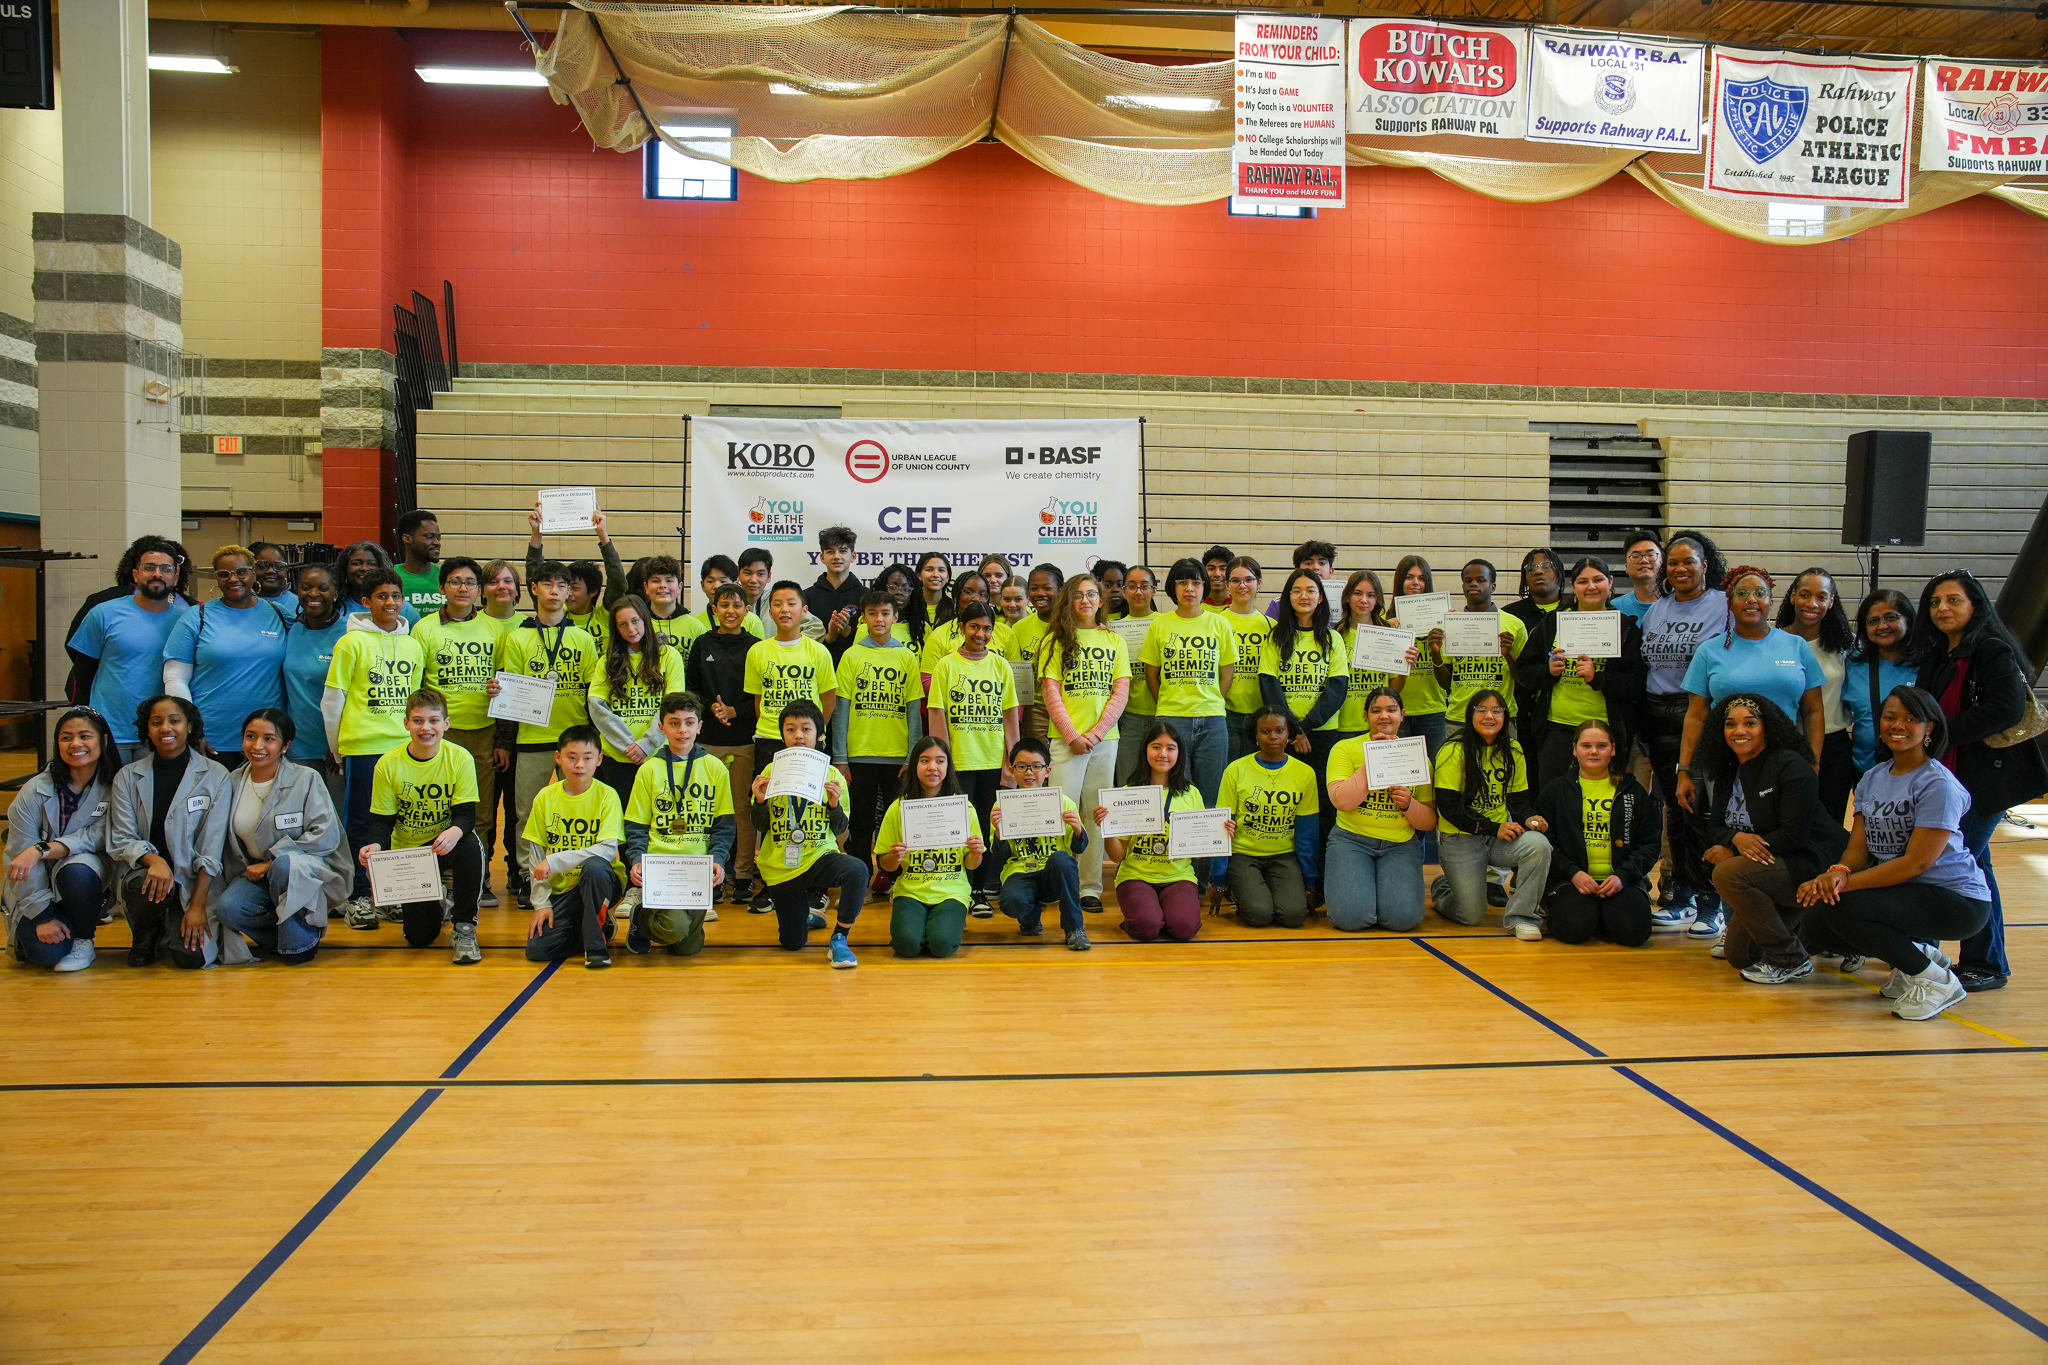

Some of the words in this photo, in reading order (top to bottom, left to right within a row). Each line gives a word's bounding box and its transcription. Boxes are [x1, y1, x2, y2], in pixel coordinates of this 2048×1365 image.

[1257, 24, 1318, 41] REMINDERS
[1239, 42, 1268, 58] FROM
[1272, 44, 1301, 60] YOUR
[1305, 46, 1340, 60] CHILD:
[1386, 29, 1491, 61] BUTCH
[1545, 39, 1632, 59] RAHWAY
[1634, 47, 1688, 64] P.B.A.
[1590, 58, 1628, 69] LOCAL
[1629, 61, 1645, 72] #31
[1264, 70, 1277, 80] KID
[1373, 57, 1505, 89] KOWAL'S
[1245, 85, 1256, 94] It's
[1258, 86, 1271, 95] Just
[1278, 87, 1299, 97] GAME
[1741, 86, 1791, 100] POLICE
[1817, 82, 1896, 110] Rahway
[1245, 101, 1256, 112] My
[1257, 101, 1277, 111] Coach
[1279, 103, 1285, 111] is
[1292, 103, 1334, 113] VOLUNTEER
[1356, 94, 1516, 119] ASSOCIATION
[1948, 102, 1981, 121] Local
[1994, 111, 2004, 121] 33
[1245, 117, 1258, 127] The
[1259, 118, 1288, 128] Referees
[1303, 120, 1335, 129] HUMANS
[1375, 117, 1428, 133] Supports
[1431, 118, 1477, 133] RAHWAY
[1479, 121, 1499, 135] PAL
[1728, 98, 1758, 154] ATHLETIC
[1742, 101, 1783, 137] PAL
[1815, 115, 1889, 137] POLICE
[1535, 116, 1597, 135] Supports
[1599, 121, 1654, 142] Rahway
[1655, 127, 1691, 143] P.A.L.
[1766, 113, 1799, 154] LEAGUE
[1245, 134, 1257, 143] NO
[1258, 135, 1284, 146] College
[1286, 136, 1329, 147] Scholarships
[1330, 137, 1342, 145] will
[1947, 128, 2048, 156] FMB
[1249, 147, 1258, 156] be
[1260, 148, 1287, 157] Handed
[1289, 148, 1302, 157] Out
[1303, 149, 1323, 159] Today
[1800, 140, 1902, 162] ATHLETIC
[1948, 155, 1995, 171] Supports
[1998, 160, 2042, 172] RAHWAY
[1247, 165, 1302, 185] RAHWAY
[1305, 167, 1337, 187] P.A.L.
[1724, 168, 1775, 179] Established
[1779, 174, 1796, 183] 1995
[1811, 165, 1890, 186] LEAGUE
[1244, 186, 1269, 195] THANK
[218, 437, 239, 453] EXIT
[726, 442, 815, 470] KOBO
[891, 454, 922, 462] URBAN
[923, 454, 957, 462] LEAGUE
[1039, 446, 1102, 465] BASF
[727, 469, 815, 479] www.koboproducts.com
[905, 463, 934, 471] UNION
[1006, 471, 1021, 480] We
[1023, 471, 1053, 480] create
[1055, 470, 1101, 482] chemistry
[766, 500, 804, 514] YOU
[1058, 501, 1098, 515] YOU
[767, 514, 782, 524] BE
[784, 514, 804, 524] THE
[877, 506, 952, 534] CEF
[1058, 515, 1072, 526] BE
[1075, 515, 1098, 526] THE
[748, 524, 804, 535] CHEMIST
[1038, 526, 1098, 537] CHEMIST
[856, 552, 884, 566] BE
[1666, 621, 1704, 634] YOU
[1178, 635, 1217, 650] YOU
[1659, 634, 1673, 643] BE
[1677, 633, 1699, 643] THE
[453, 642, 494, 656] YOU
[1179, 649, 1193, 659] BE
[1196, 649, 1216, 661] THE
[1641, 643, 1696, 655] CHEMIST
[456, 655, 470, 666] BE
[473, 655, 493, 667] THE
[1163, 660, 1215, 672] CHEMIST
[437, 666, 493, 678] CHEMIST
[775, 665, 816, 680] YOU
[872, 666, 908, 685] YOU
[776, 679, 789, 689] BE
[792, 679, 813, 690] THE
[872, 681, 886, 691] BE
[967, 679, 1003, 696] YOU
[763, 690, 813, 700] CHEMIST
[968, 694, 981, 705] BE
[985, 694, 1002, 707] THE
[861, 703, 900, 712] CHALLENGE
[1112, 799, 1150, 808] CHAMPION
[1263, 790, 1304, 806] YOU
[1263, 805, 1278, 816] BE
[1871, 800, 1910, 817] YOU
[1243, 814, 1293, 826] CHEMIS
[1868, 816, 1881, 830] BE
[1883, 816, 1914, 830] THE
